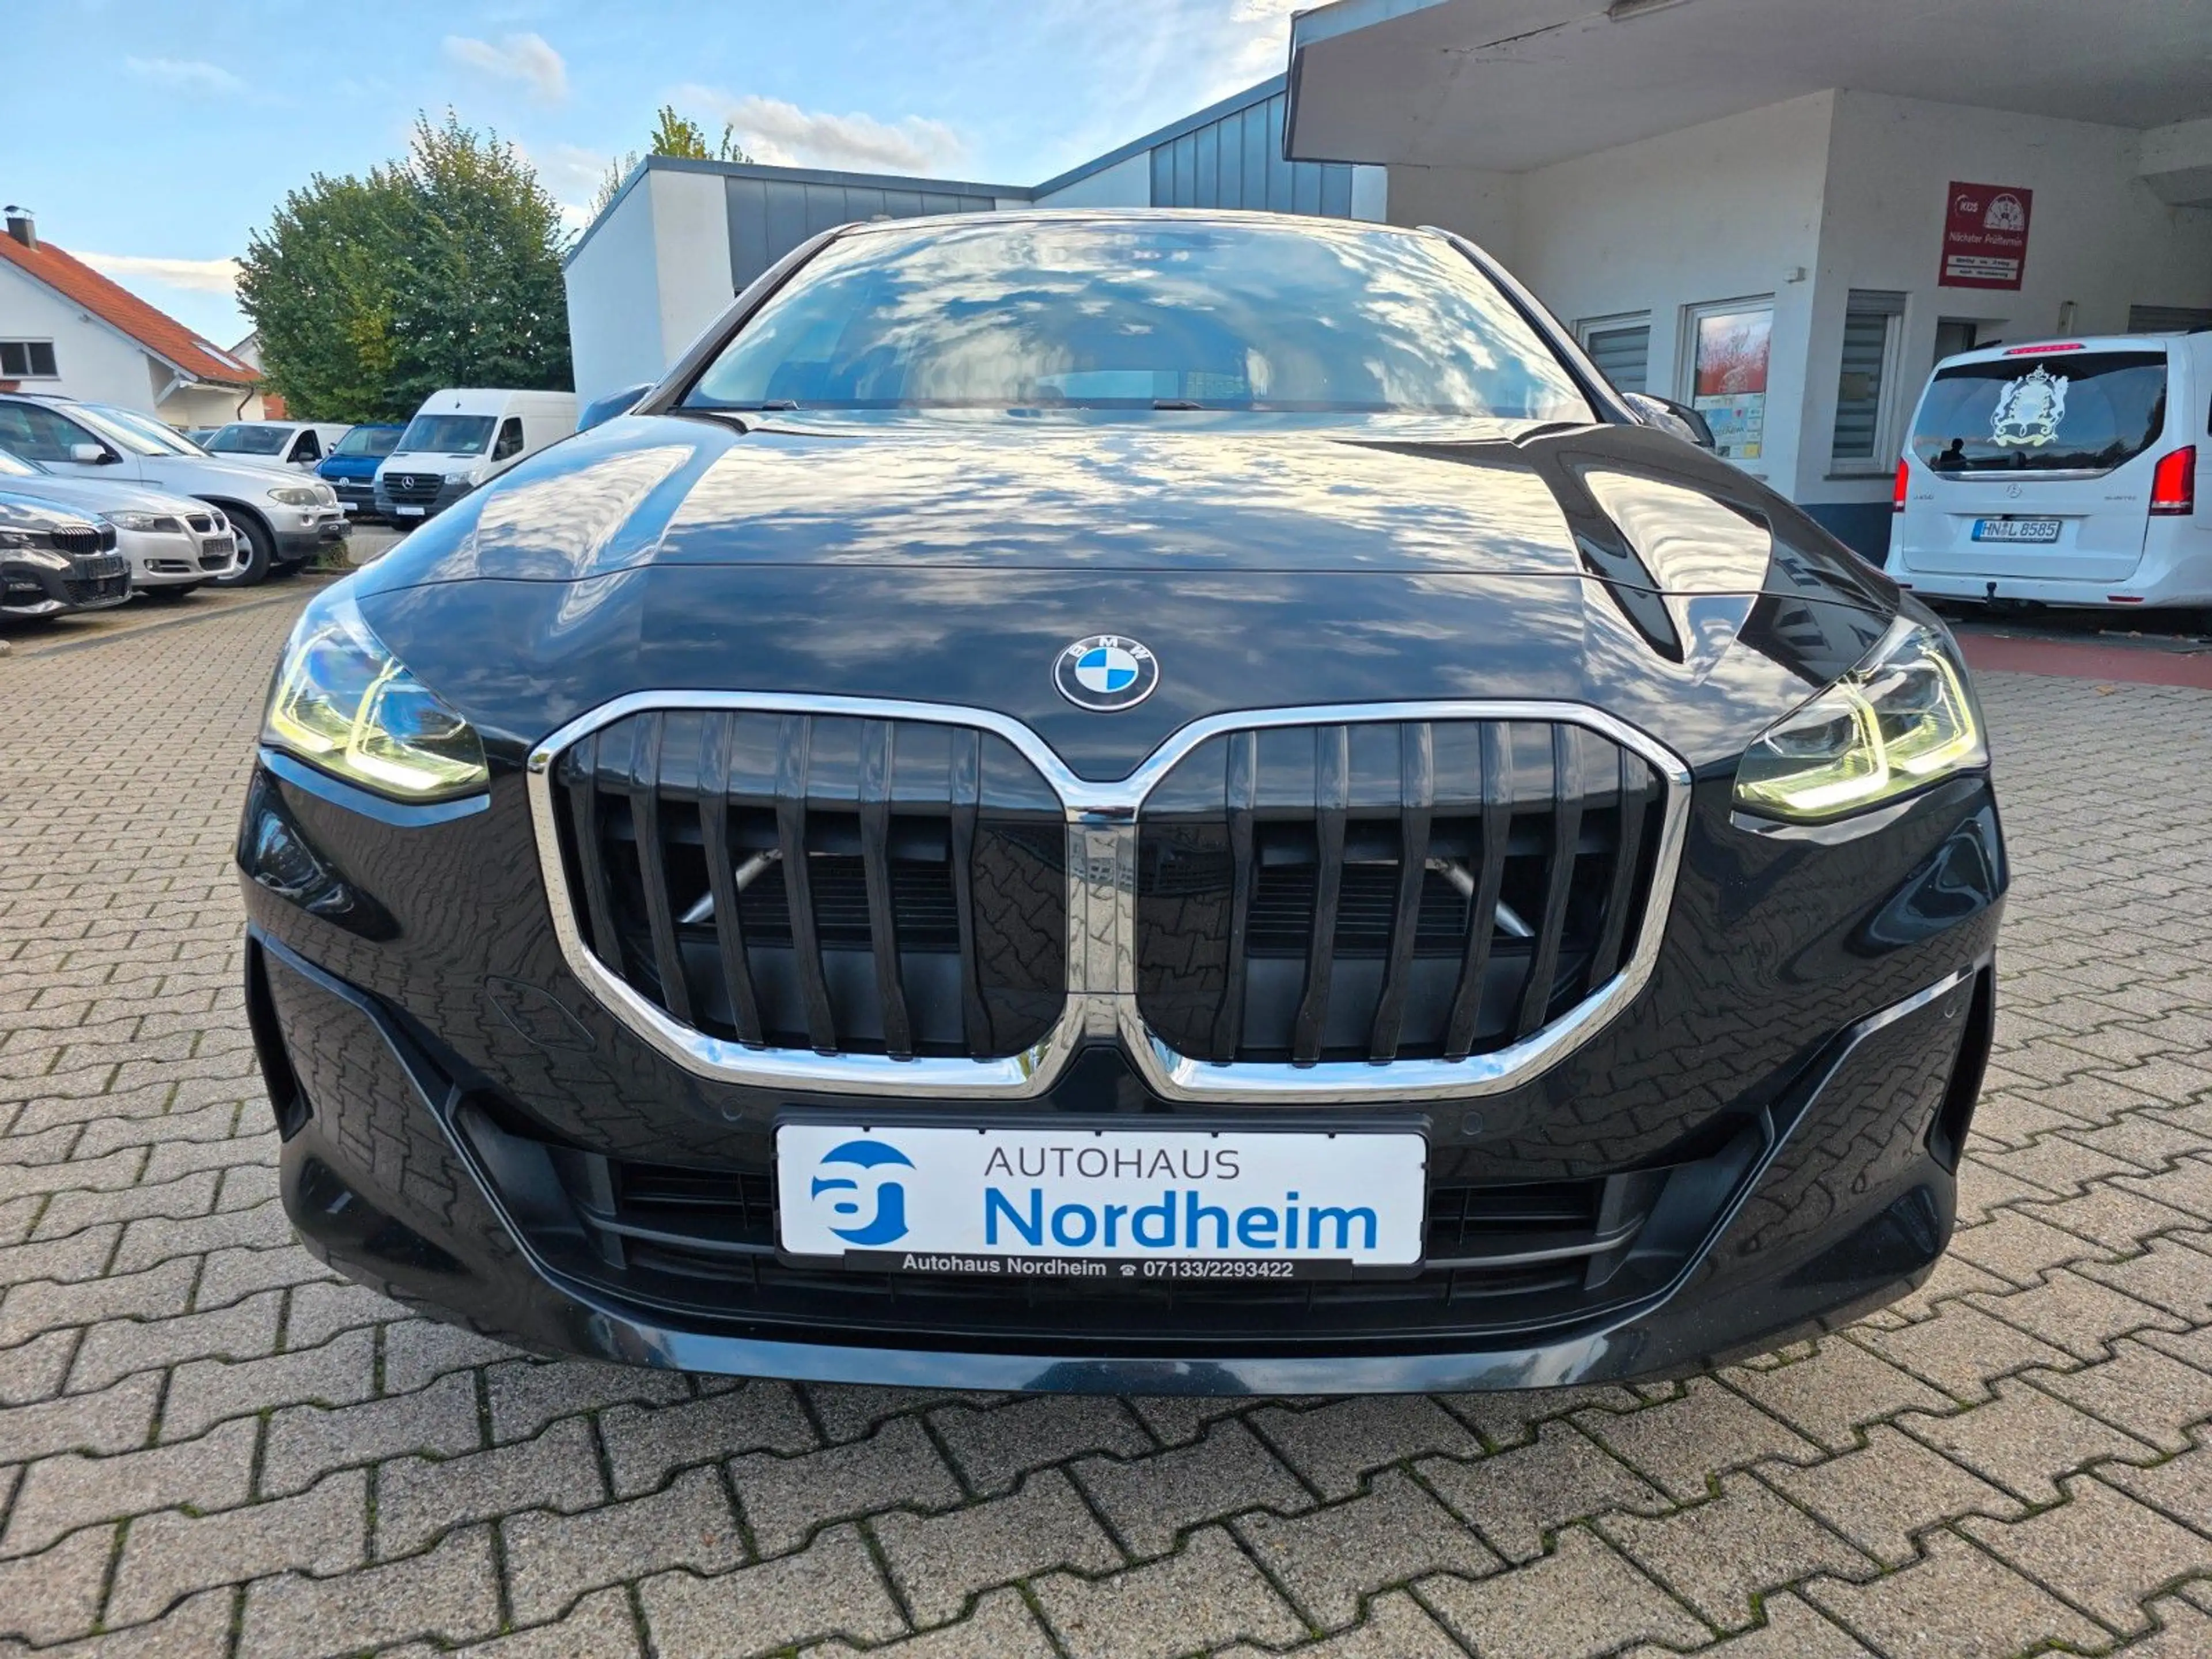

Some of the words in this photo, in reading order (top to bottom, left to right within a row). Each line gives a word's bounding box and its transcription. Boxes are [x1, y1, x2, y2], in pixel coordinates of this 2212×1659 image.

[1982, 522, 2002, 536] HN
[2008, 522, 2017, 536] L
[2020, 522, 2057, 537] 8585
[1067, 637, 1151, 660] BMW
[984, 1146, 1240, 1180] AUTOHAUS
[984, 1187, 1377, 1249] Nordheim
[902, 1253, 1001, 1273] Autohaus
[1007, 1257, 1107, 1276] Nordheim
[1143, 1260, 1294, 1277] 07133/2293422
